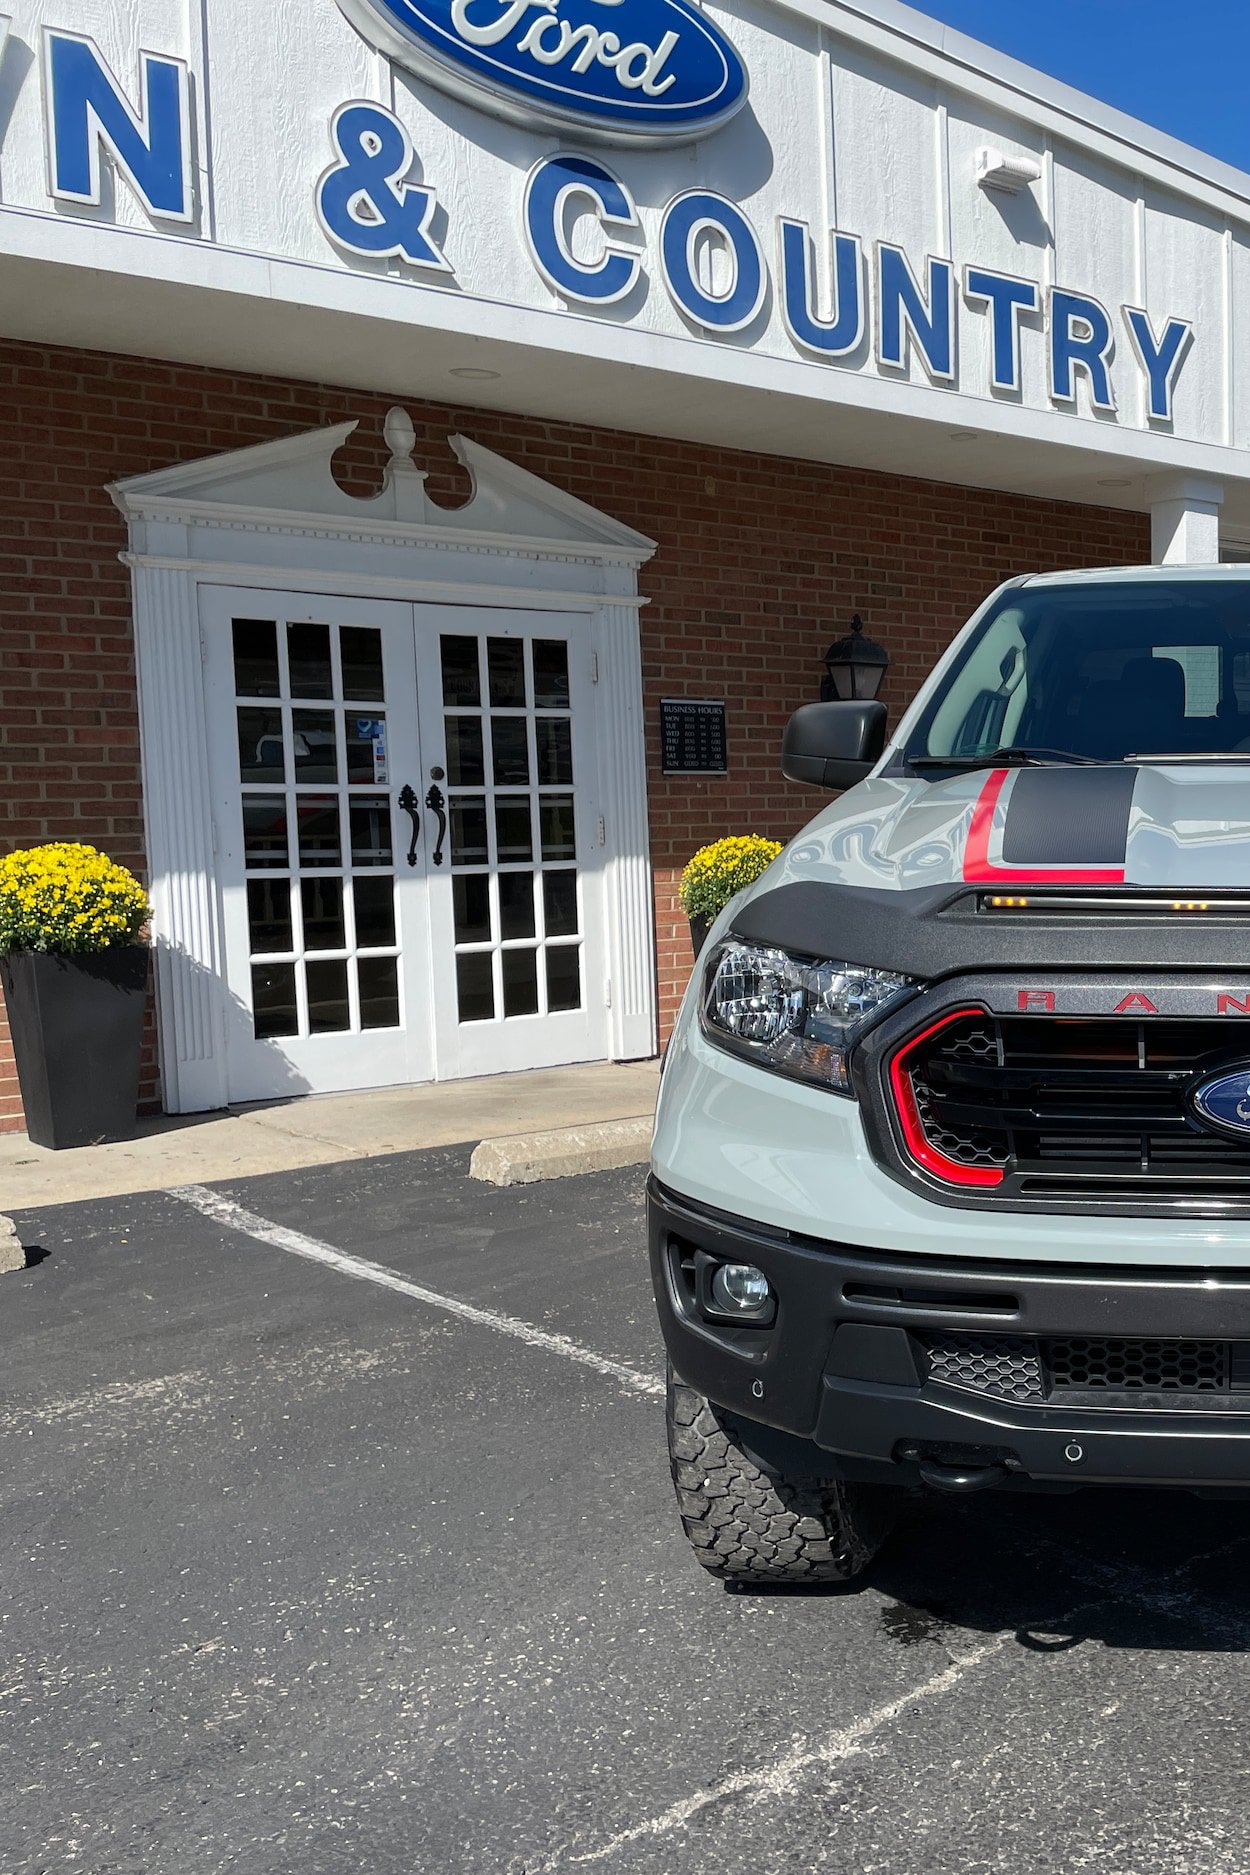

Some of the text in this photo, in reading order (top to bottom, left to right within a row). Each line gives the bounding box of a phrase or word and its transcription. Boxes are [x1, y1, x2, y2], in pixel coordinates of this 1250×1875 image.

[0, 14, 1193, 422] N & COUNTRY
[664, 705, 723, 715] BUSINESS HOURS
